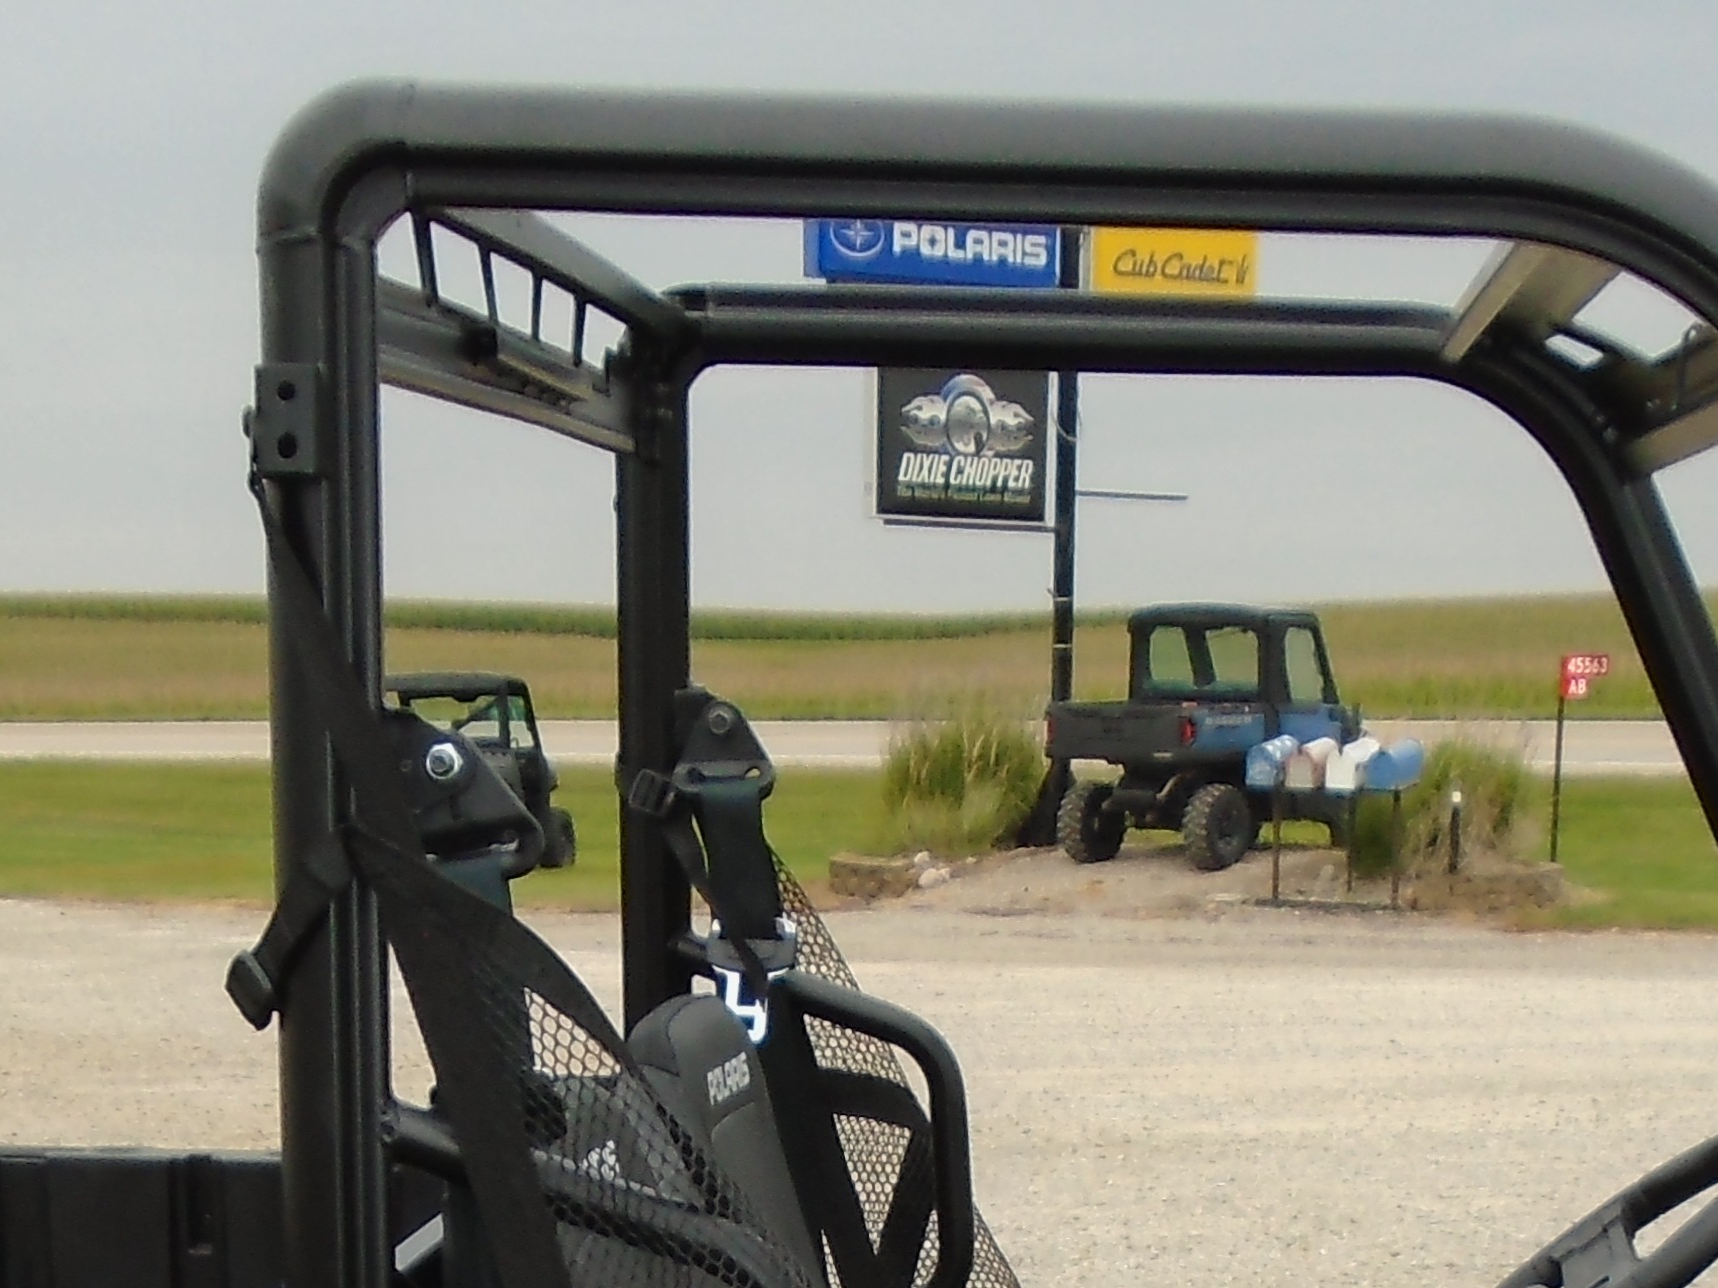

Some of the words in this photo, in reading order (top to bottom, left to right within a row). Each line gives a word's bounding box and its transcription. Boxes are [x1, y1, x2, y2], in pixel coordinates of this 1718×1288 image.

[893, 222, 1047, 267] POLARIS
[1113, 249, 1158, 277] Cub
[1161, 252, 1234, 283] Cadet
[898, 451, 950, 483] DIXIE
[950, 454, 1035, 488] CHOPPER
[1567, 656, 1608, 674] 45563
[1567, 678, 1587, 695] AB
[707, 1051, 751, 1106] POLARIS
